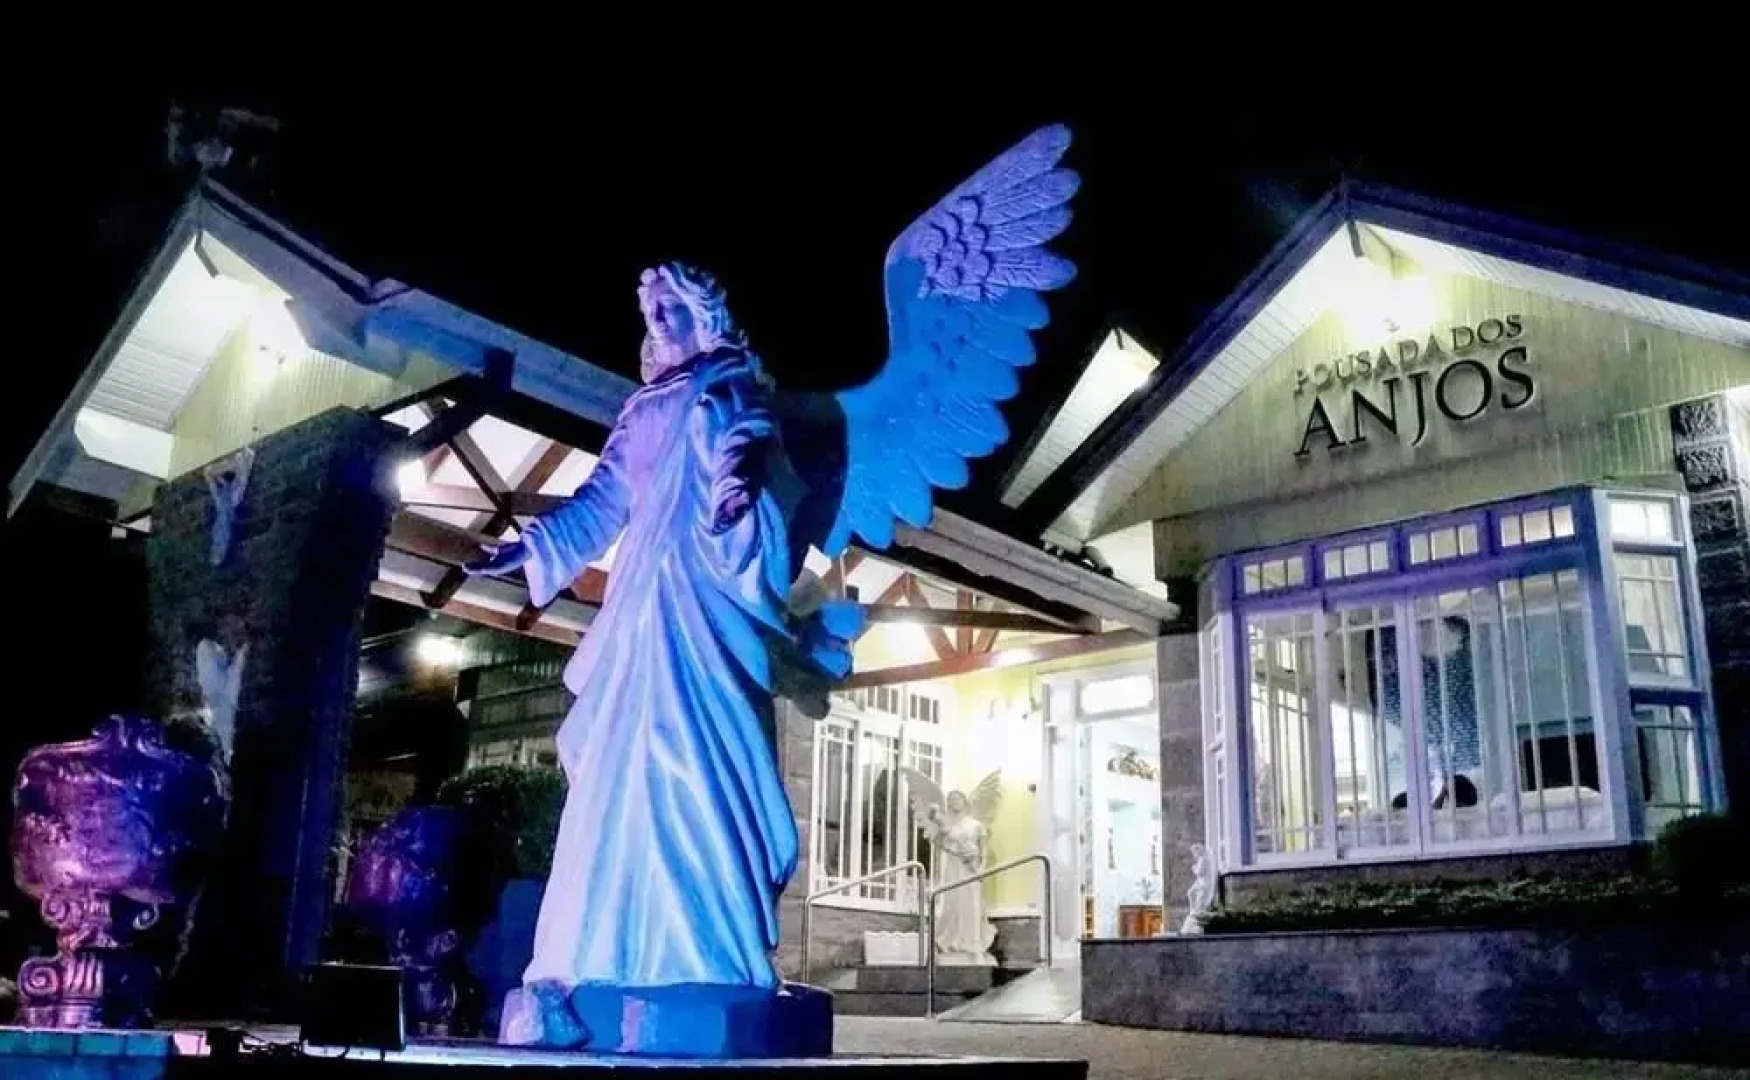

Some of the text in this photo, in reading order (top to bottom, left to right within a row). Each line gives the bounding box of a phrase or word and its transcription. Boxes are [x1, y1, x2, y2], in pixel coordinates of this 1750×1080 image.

[1293, 346, 1534, 456] ANJOS
[1294, 314, 1523, 396] POUSADA DOS
